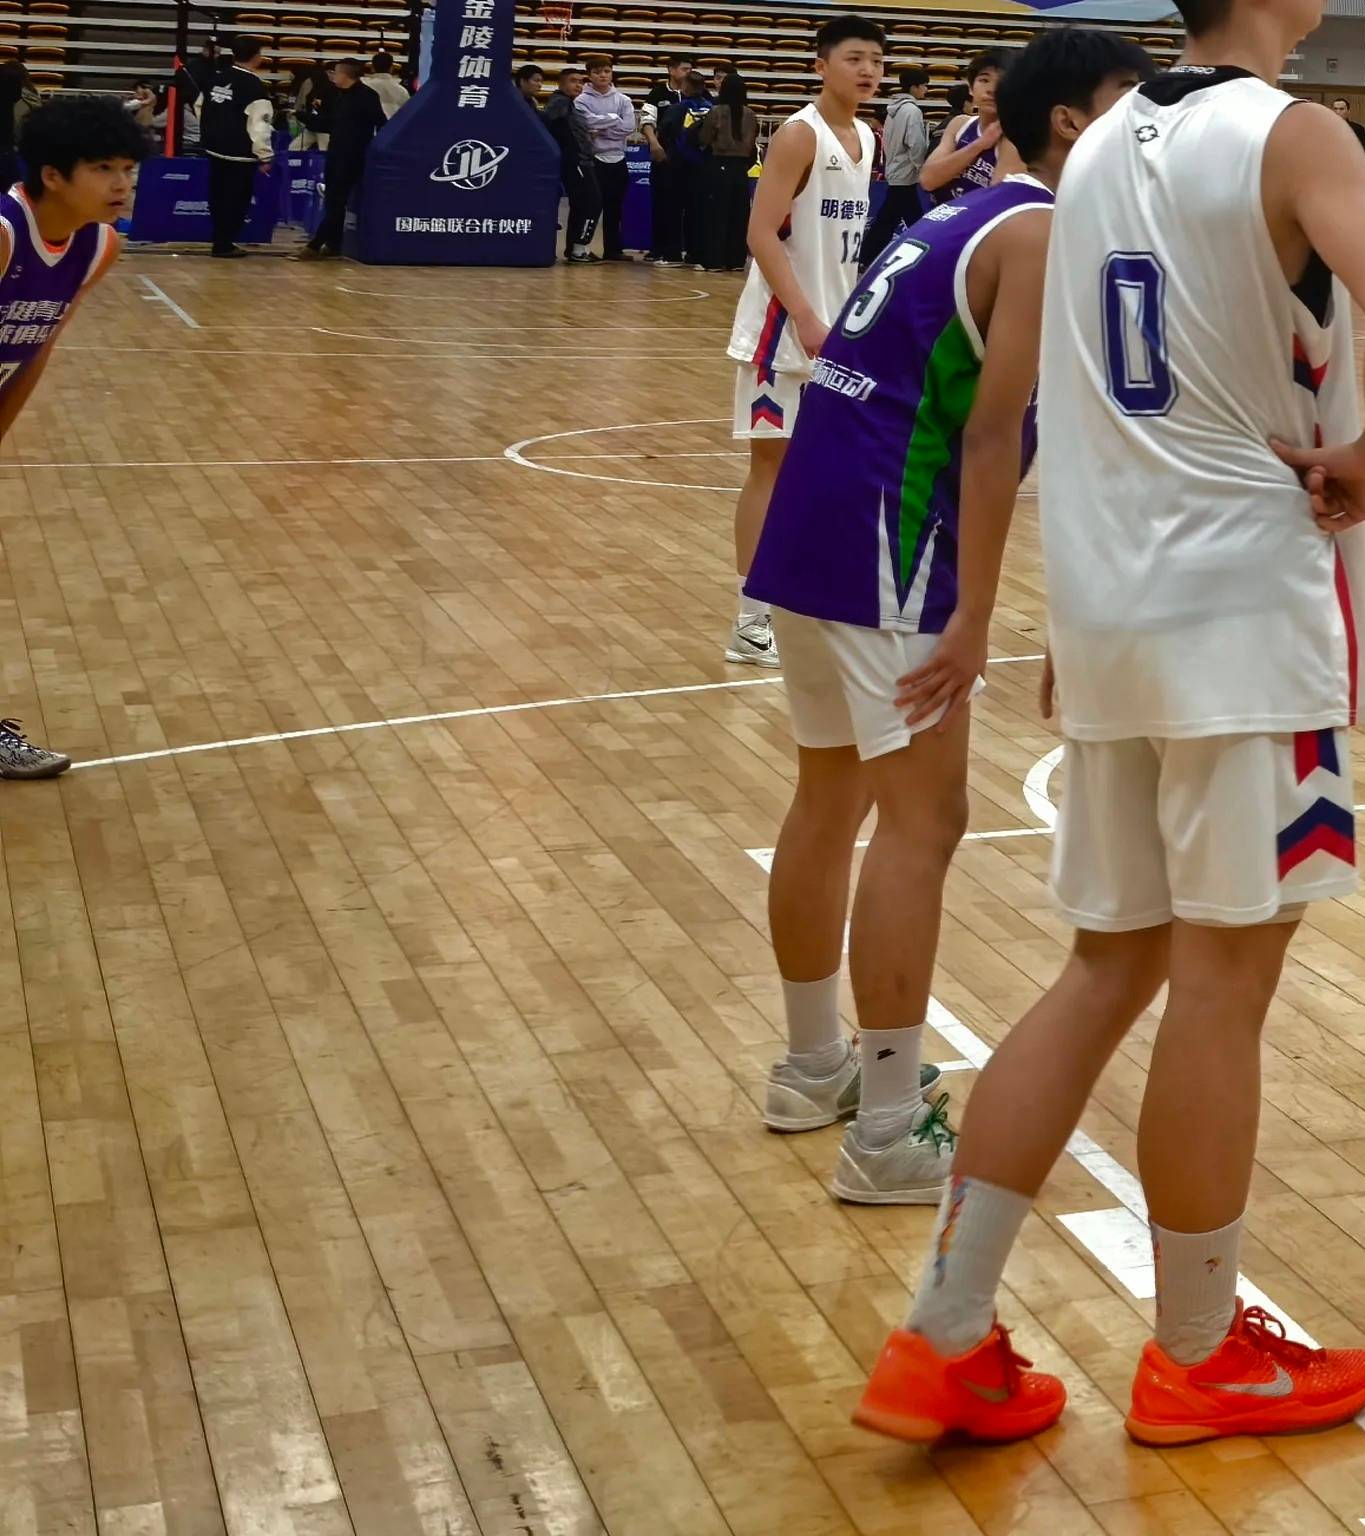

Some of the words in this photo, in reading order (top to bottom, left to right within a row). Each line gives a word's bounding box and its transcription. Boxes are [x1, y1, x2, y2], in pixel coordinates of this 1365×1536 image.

[820, 197, 869, 221] 明德华
[841, 238, 931, 340] 3
[1101, 250, 1180, 416] 0
